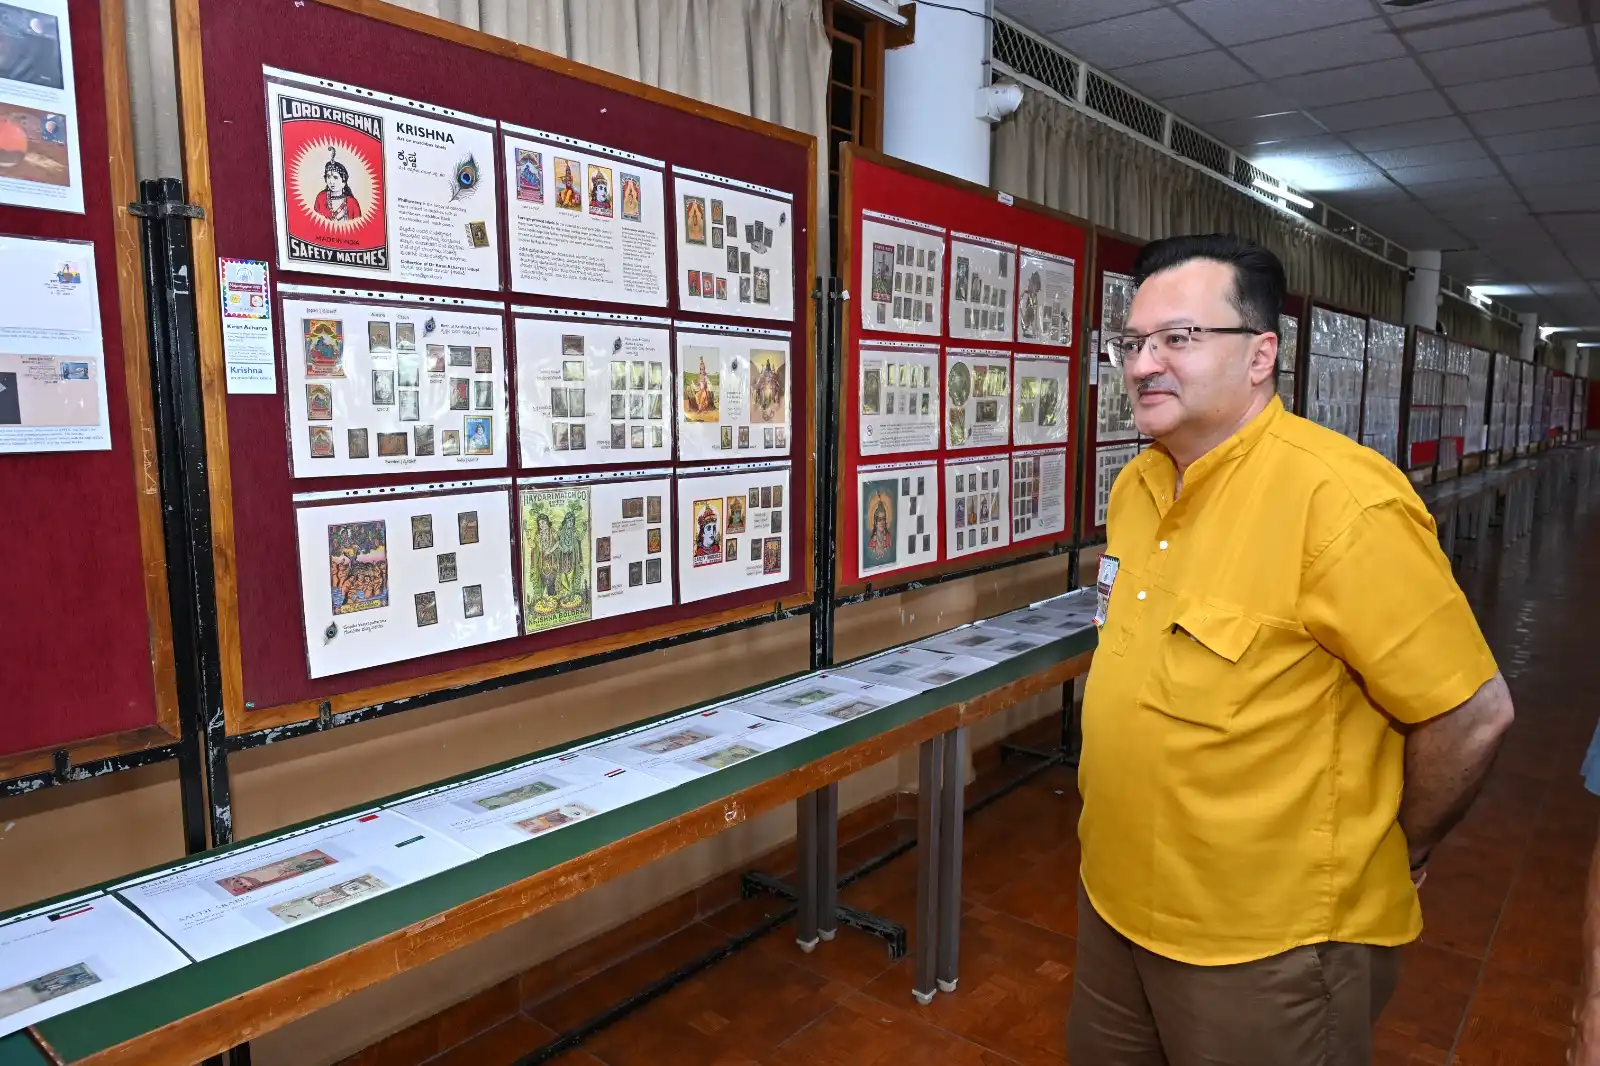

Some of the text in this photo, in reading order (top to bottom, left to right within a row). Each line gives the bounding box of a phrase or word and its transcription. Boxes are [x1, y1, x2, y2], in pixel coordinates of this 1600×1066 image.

[282, 98, 381, 139] LORD KRISHNA
[397, 122, 455, 144] KRISHNA
[291, 238, 386, 266] SAFETY MATCHES
[243, 324, 268, 332] Acharya
[230, 366, 263, 374] Krishna
[523, 493, 554, 507] HAYDARI
[554, 491, 576, 501] MATCH
[528, 614, 557, 625] KRISHNA
